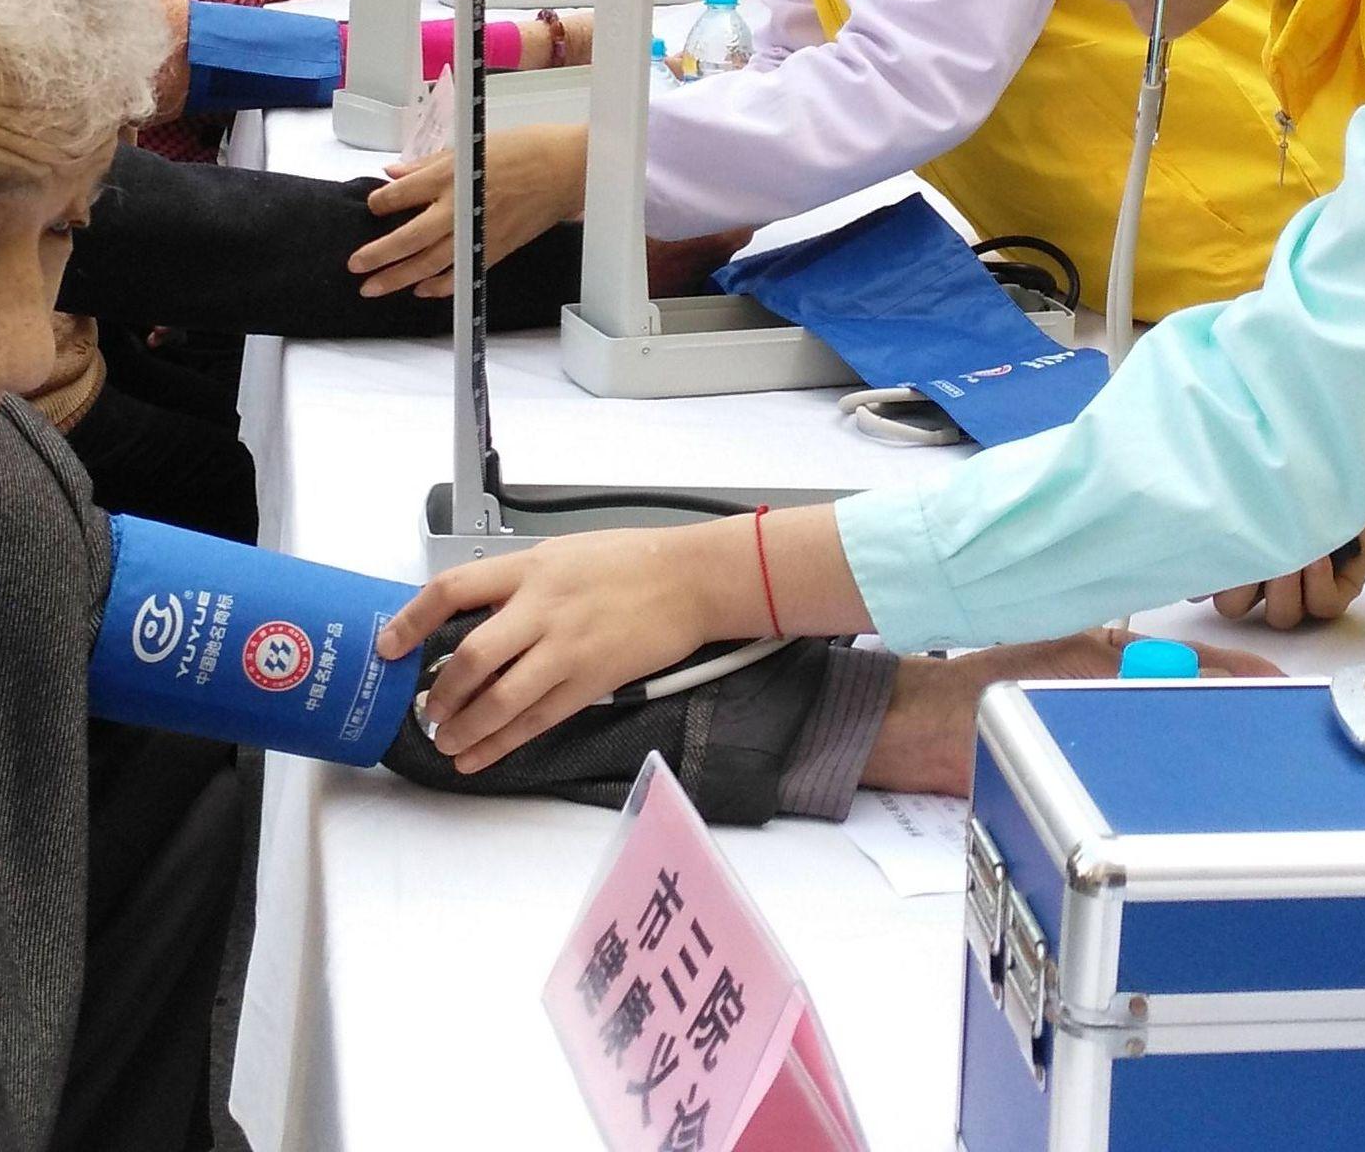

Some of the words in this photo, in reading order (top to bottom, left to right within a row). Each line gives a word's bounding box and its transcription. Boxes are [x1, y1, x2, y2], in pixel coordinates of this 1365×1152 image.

[176, 590, 211, 678] YUYUE
[196, 594, 234, 685] 中国驰名商标
[305, 622, 344, 711] 中国名牌产品
[637, 866, 745, 1073] 市三院
